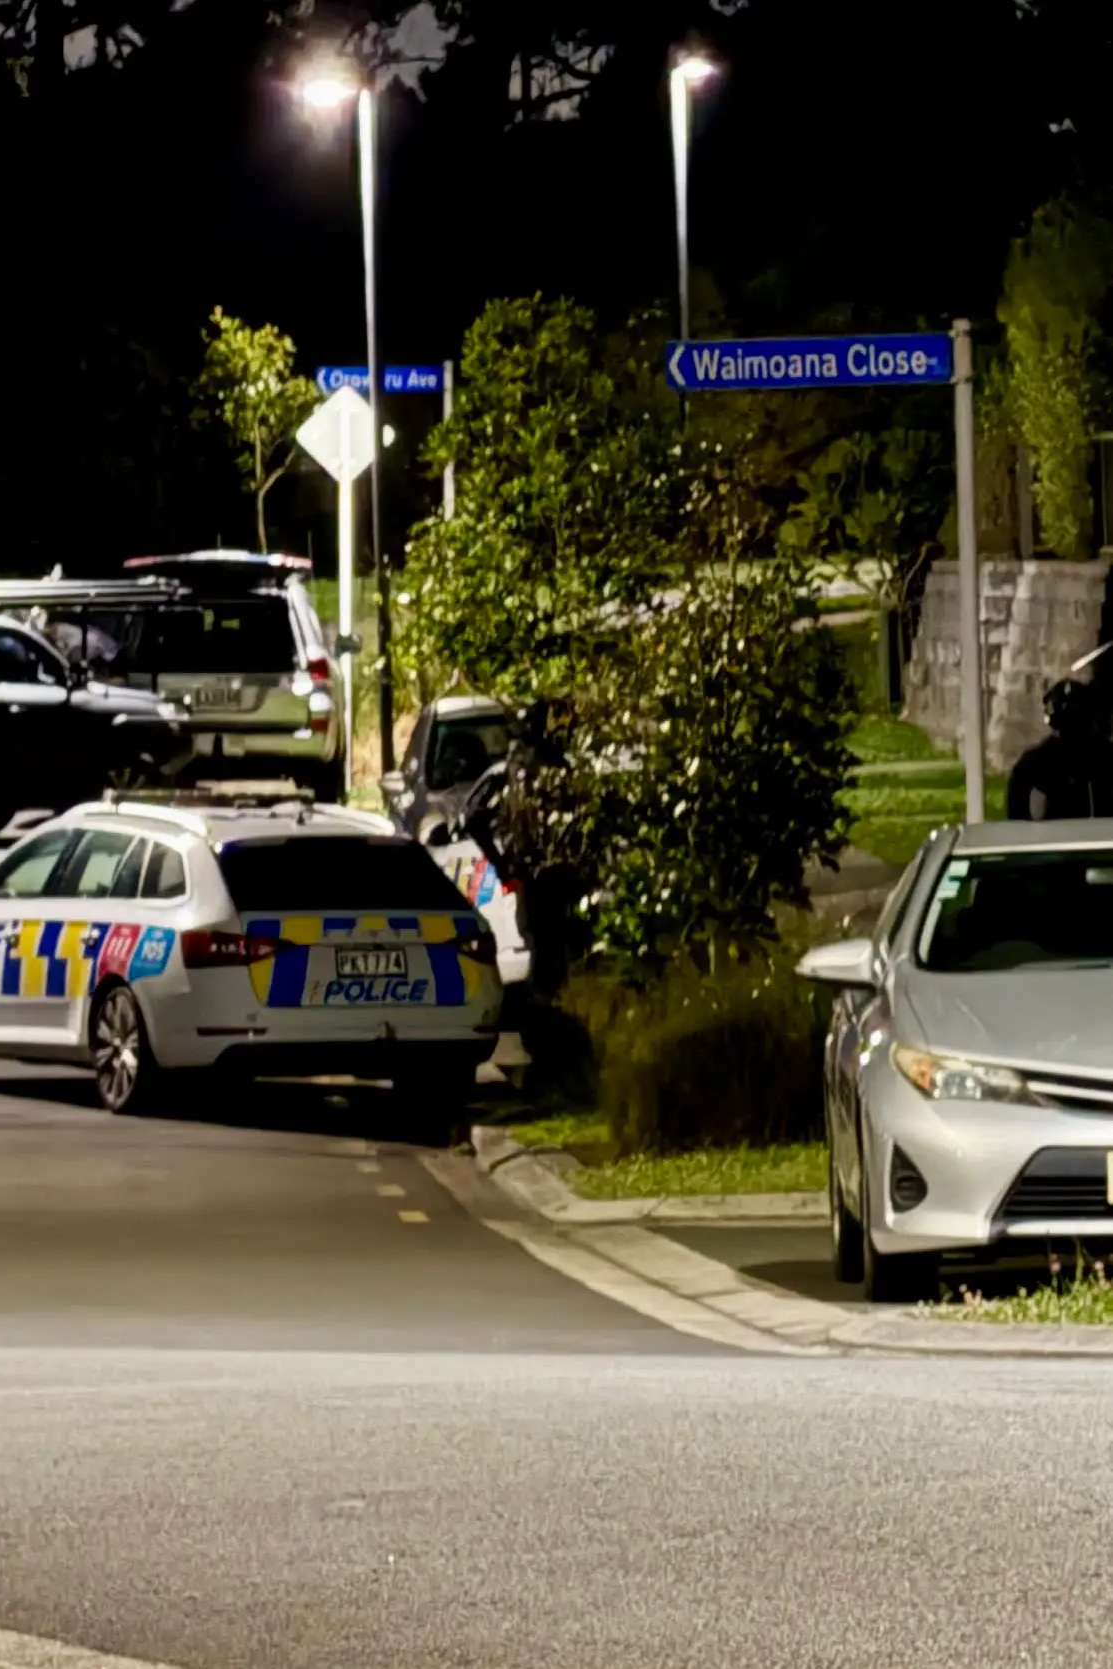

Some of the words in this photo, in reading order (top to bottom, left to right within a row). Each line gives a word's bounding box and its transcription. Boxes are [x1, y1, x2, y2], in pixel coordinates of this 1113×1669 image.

[692, 348, 838, 381] Waimoana
[846, 343, 928, 377] Close
[406, 369, 438, 388] Ave
[324, 978, 429, 1004] POLICE
